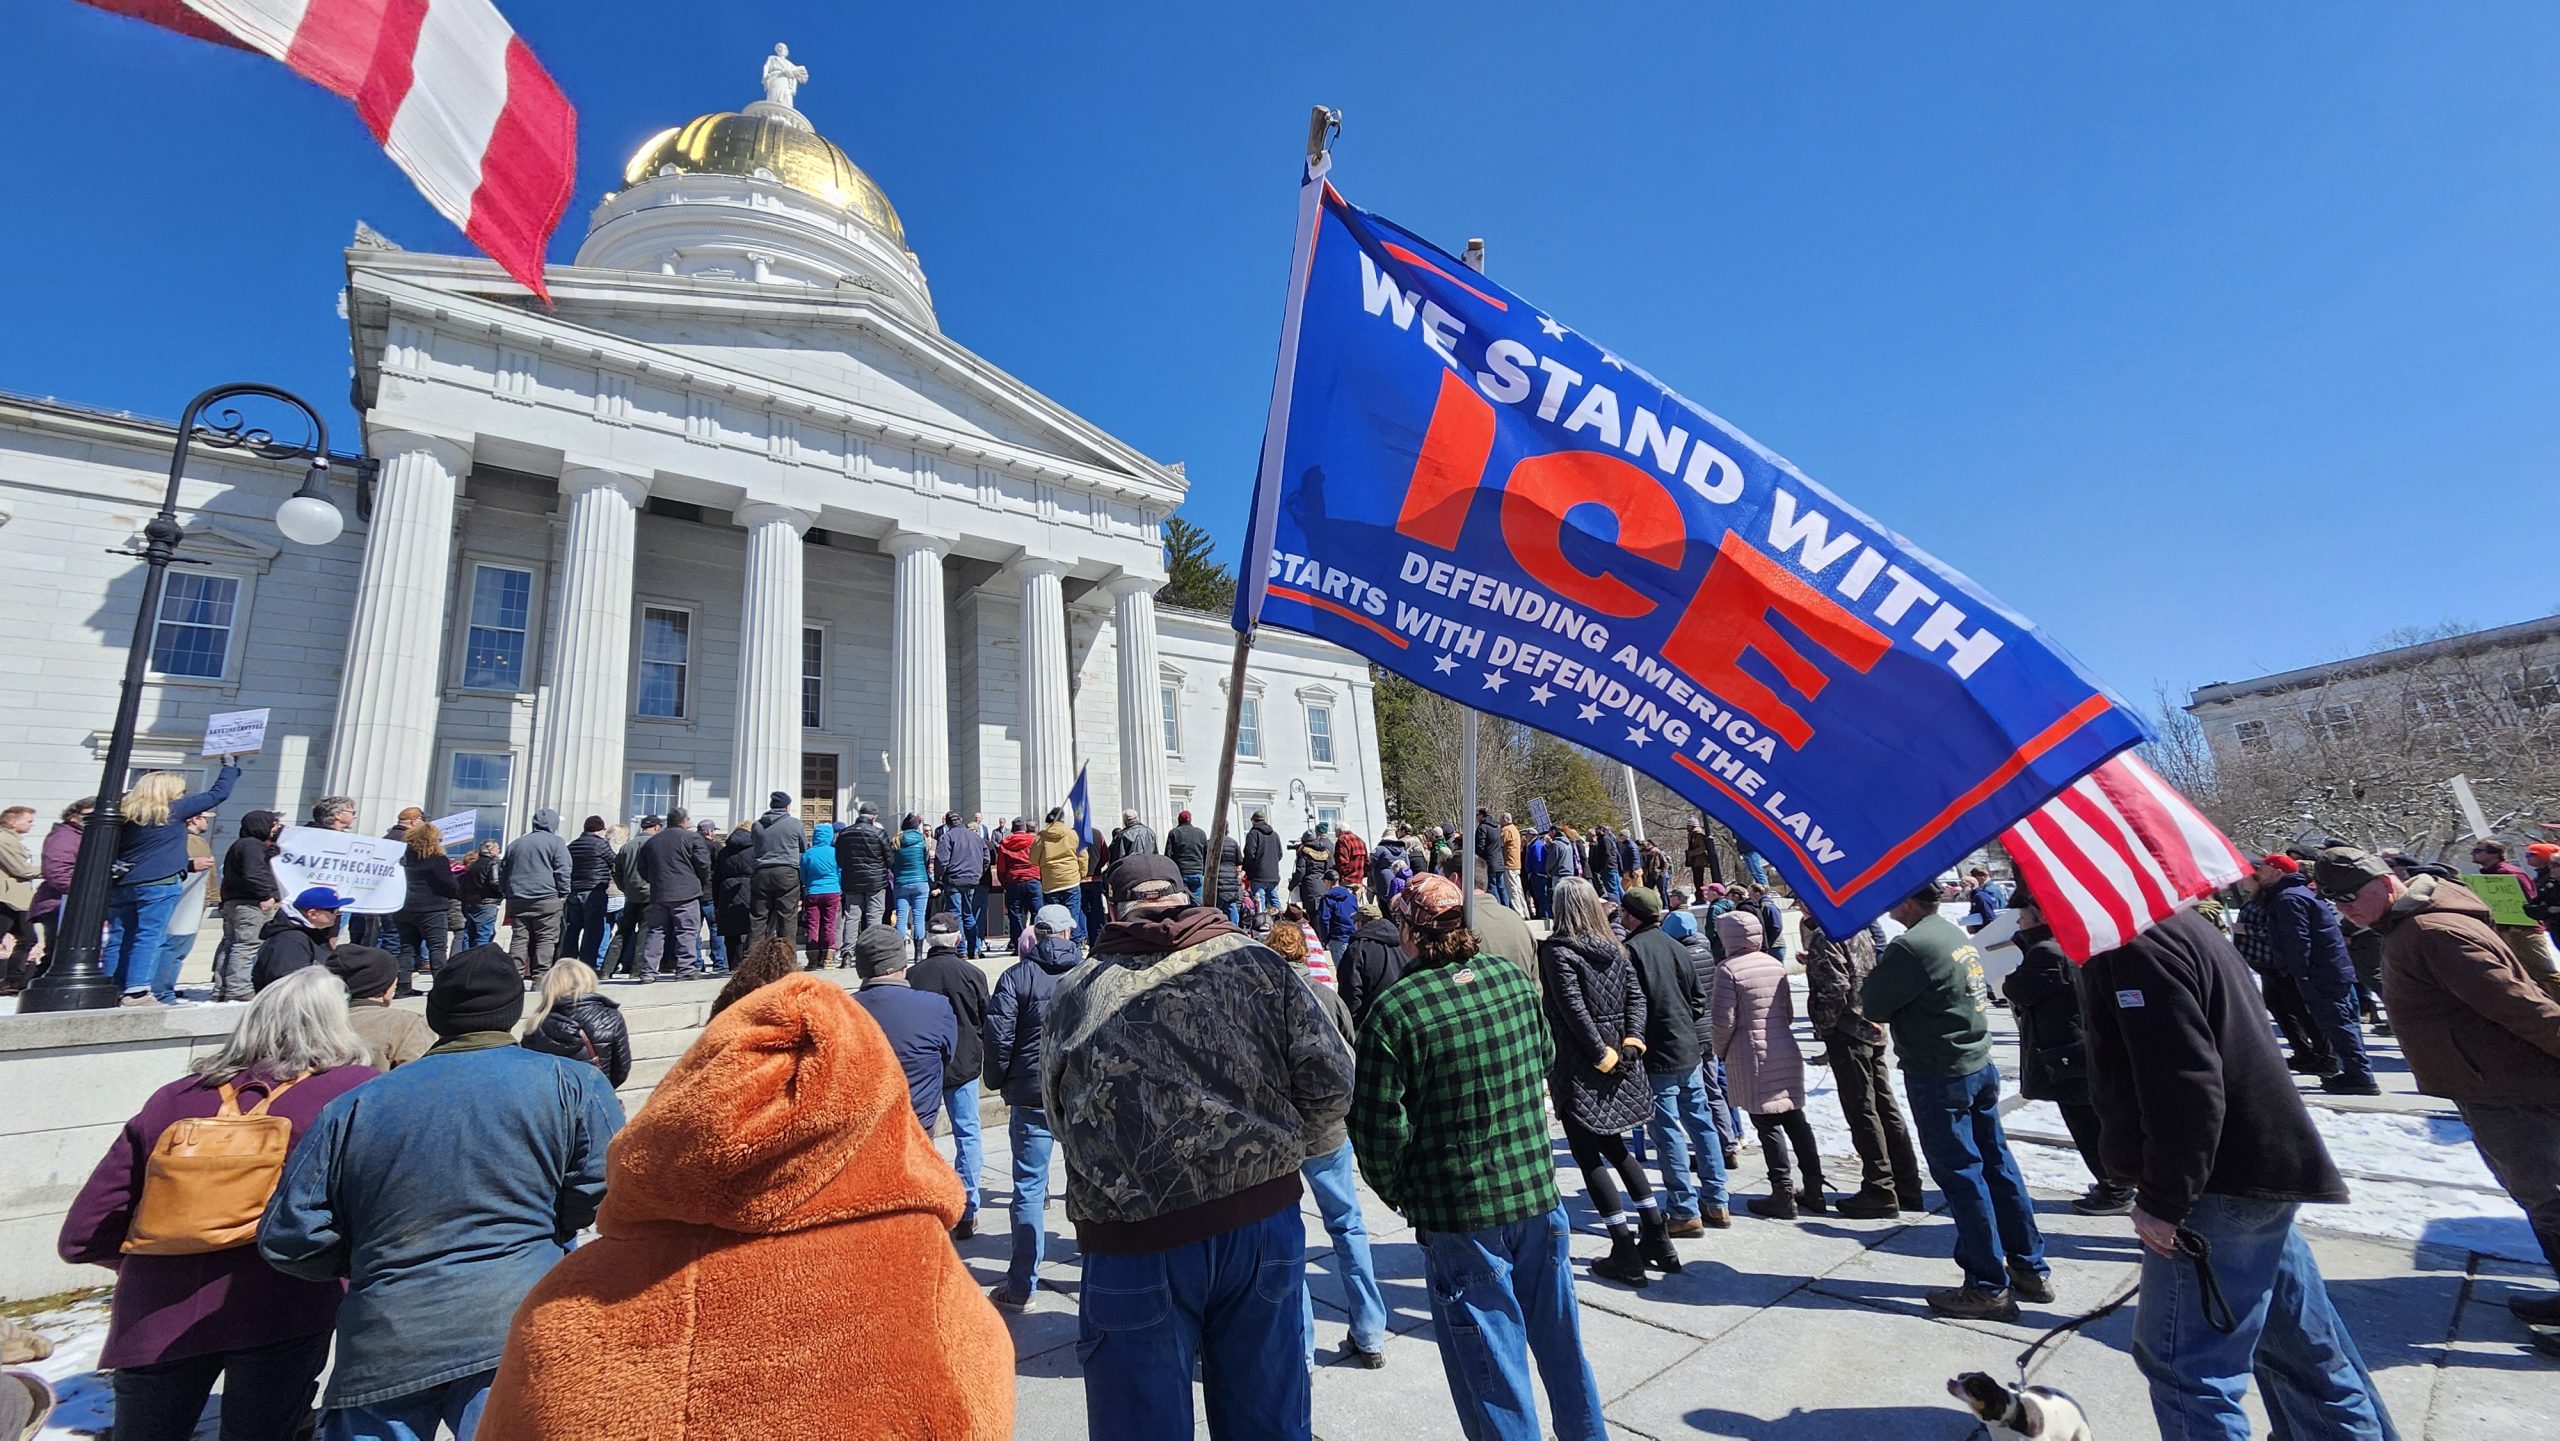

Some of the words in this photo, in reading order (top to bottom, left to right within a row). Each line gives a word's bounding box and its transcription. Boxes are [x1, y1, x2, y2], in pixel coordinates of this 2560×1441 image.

[1359, 250, 1466, 369] WE
[1476, 339, 1745, 505] STAND
[1768, 486, 2004, 680] WITH
[1395, 366, 1894, 751] ICE
[1269, 550, 1388, 616] STARTS
[1395, 600, 1486, 658] WITH
[1488, 635, 1691, 747] DEFENDING
[1695, 737, 1767, 797] THE
[1763, 791, 1846, 865] LAW
[1400, 551, 1610, 653] DEFENDING
[1611, 644, 1777, 764] AMERICA
